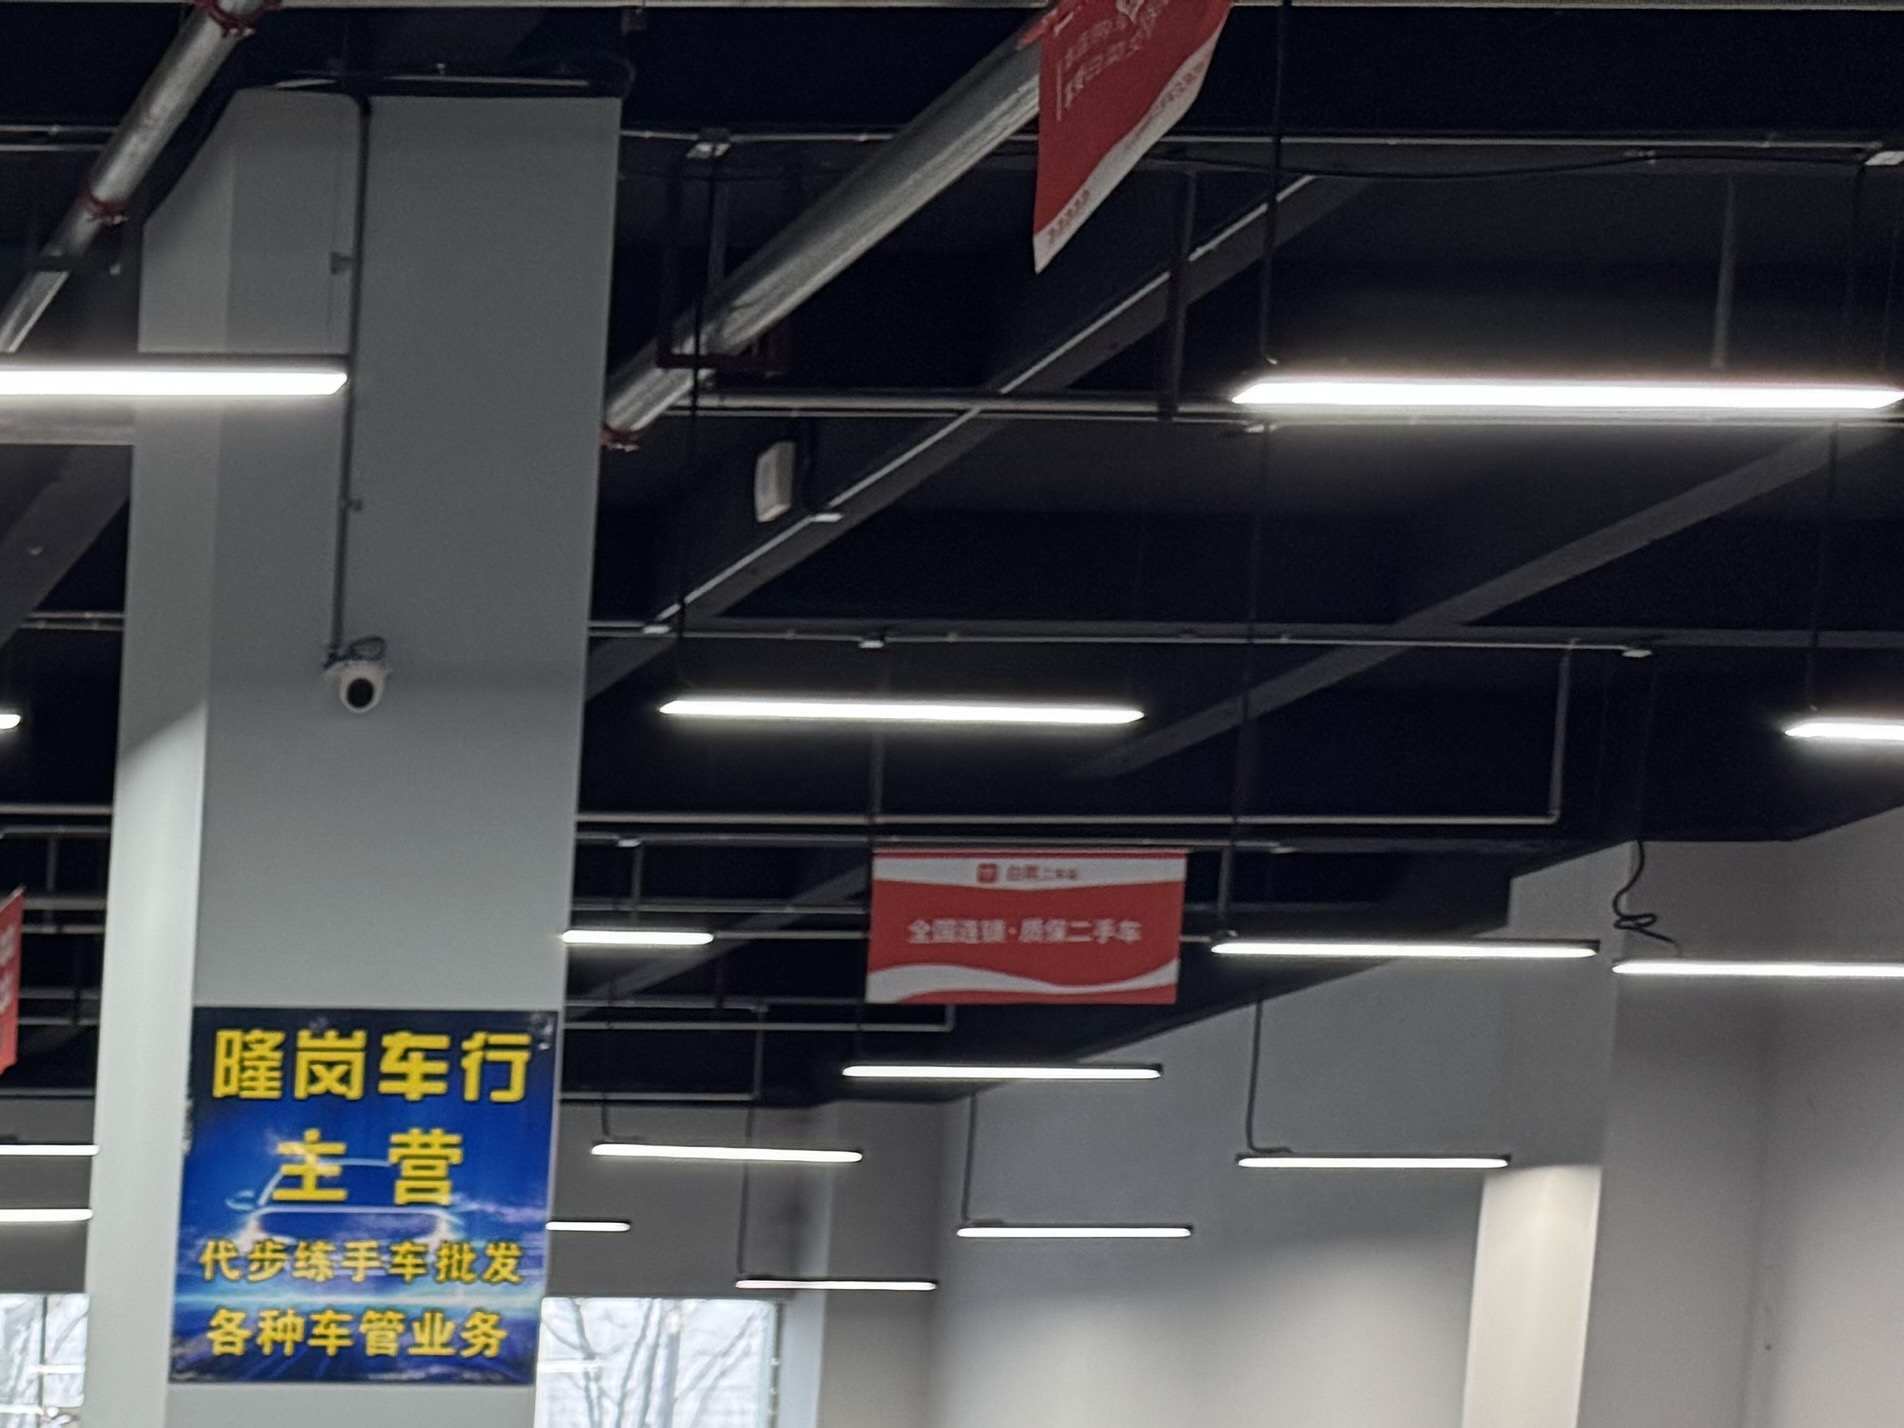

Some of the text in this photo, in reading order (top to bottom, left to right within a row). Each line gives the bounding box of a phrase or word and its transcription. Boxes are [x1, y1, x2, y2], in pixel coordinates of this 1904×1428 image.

[212, 1029, 533, 1103] 隆岗车行
[272, 1128, 464, 1206] 主营
[198, 1238, 525, 1284] 代步练手车批发
[206, 1307, 509, 1359] 各种车管业务
